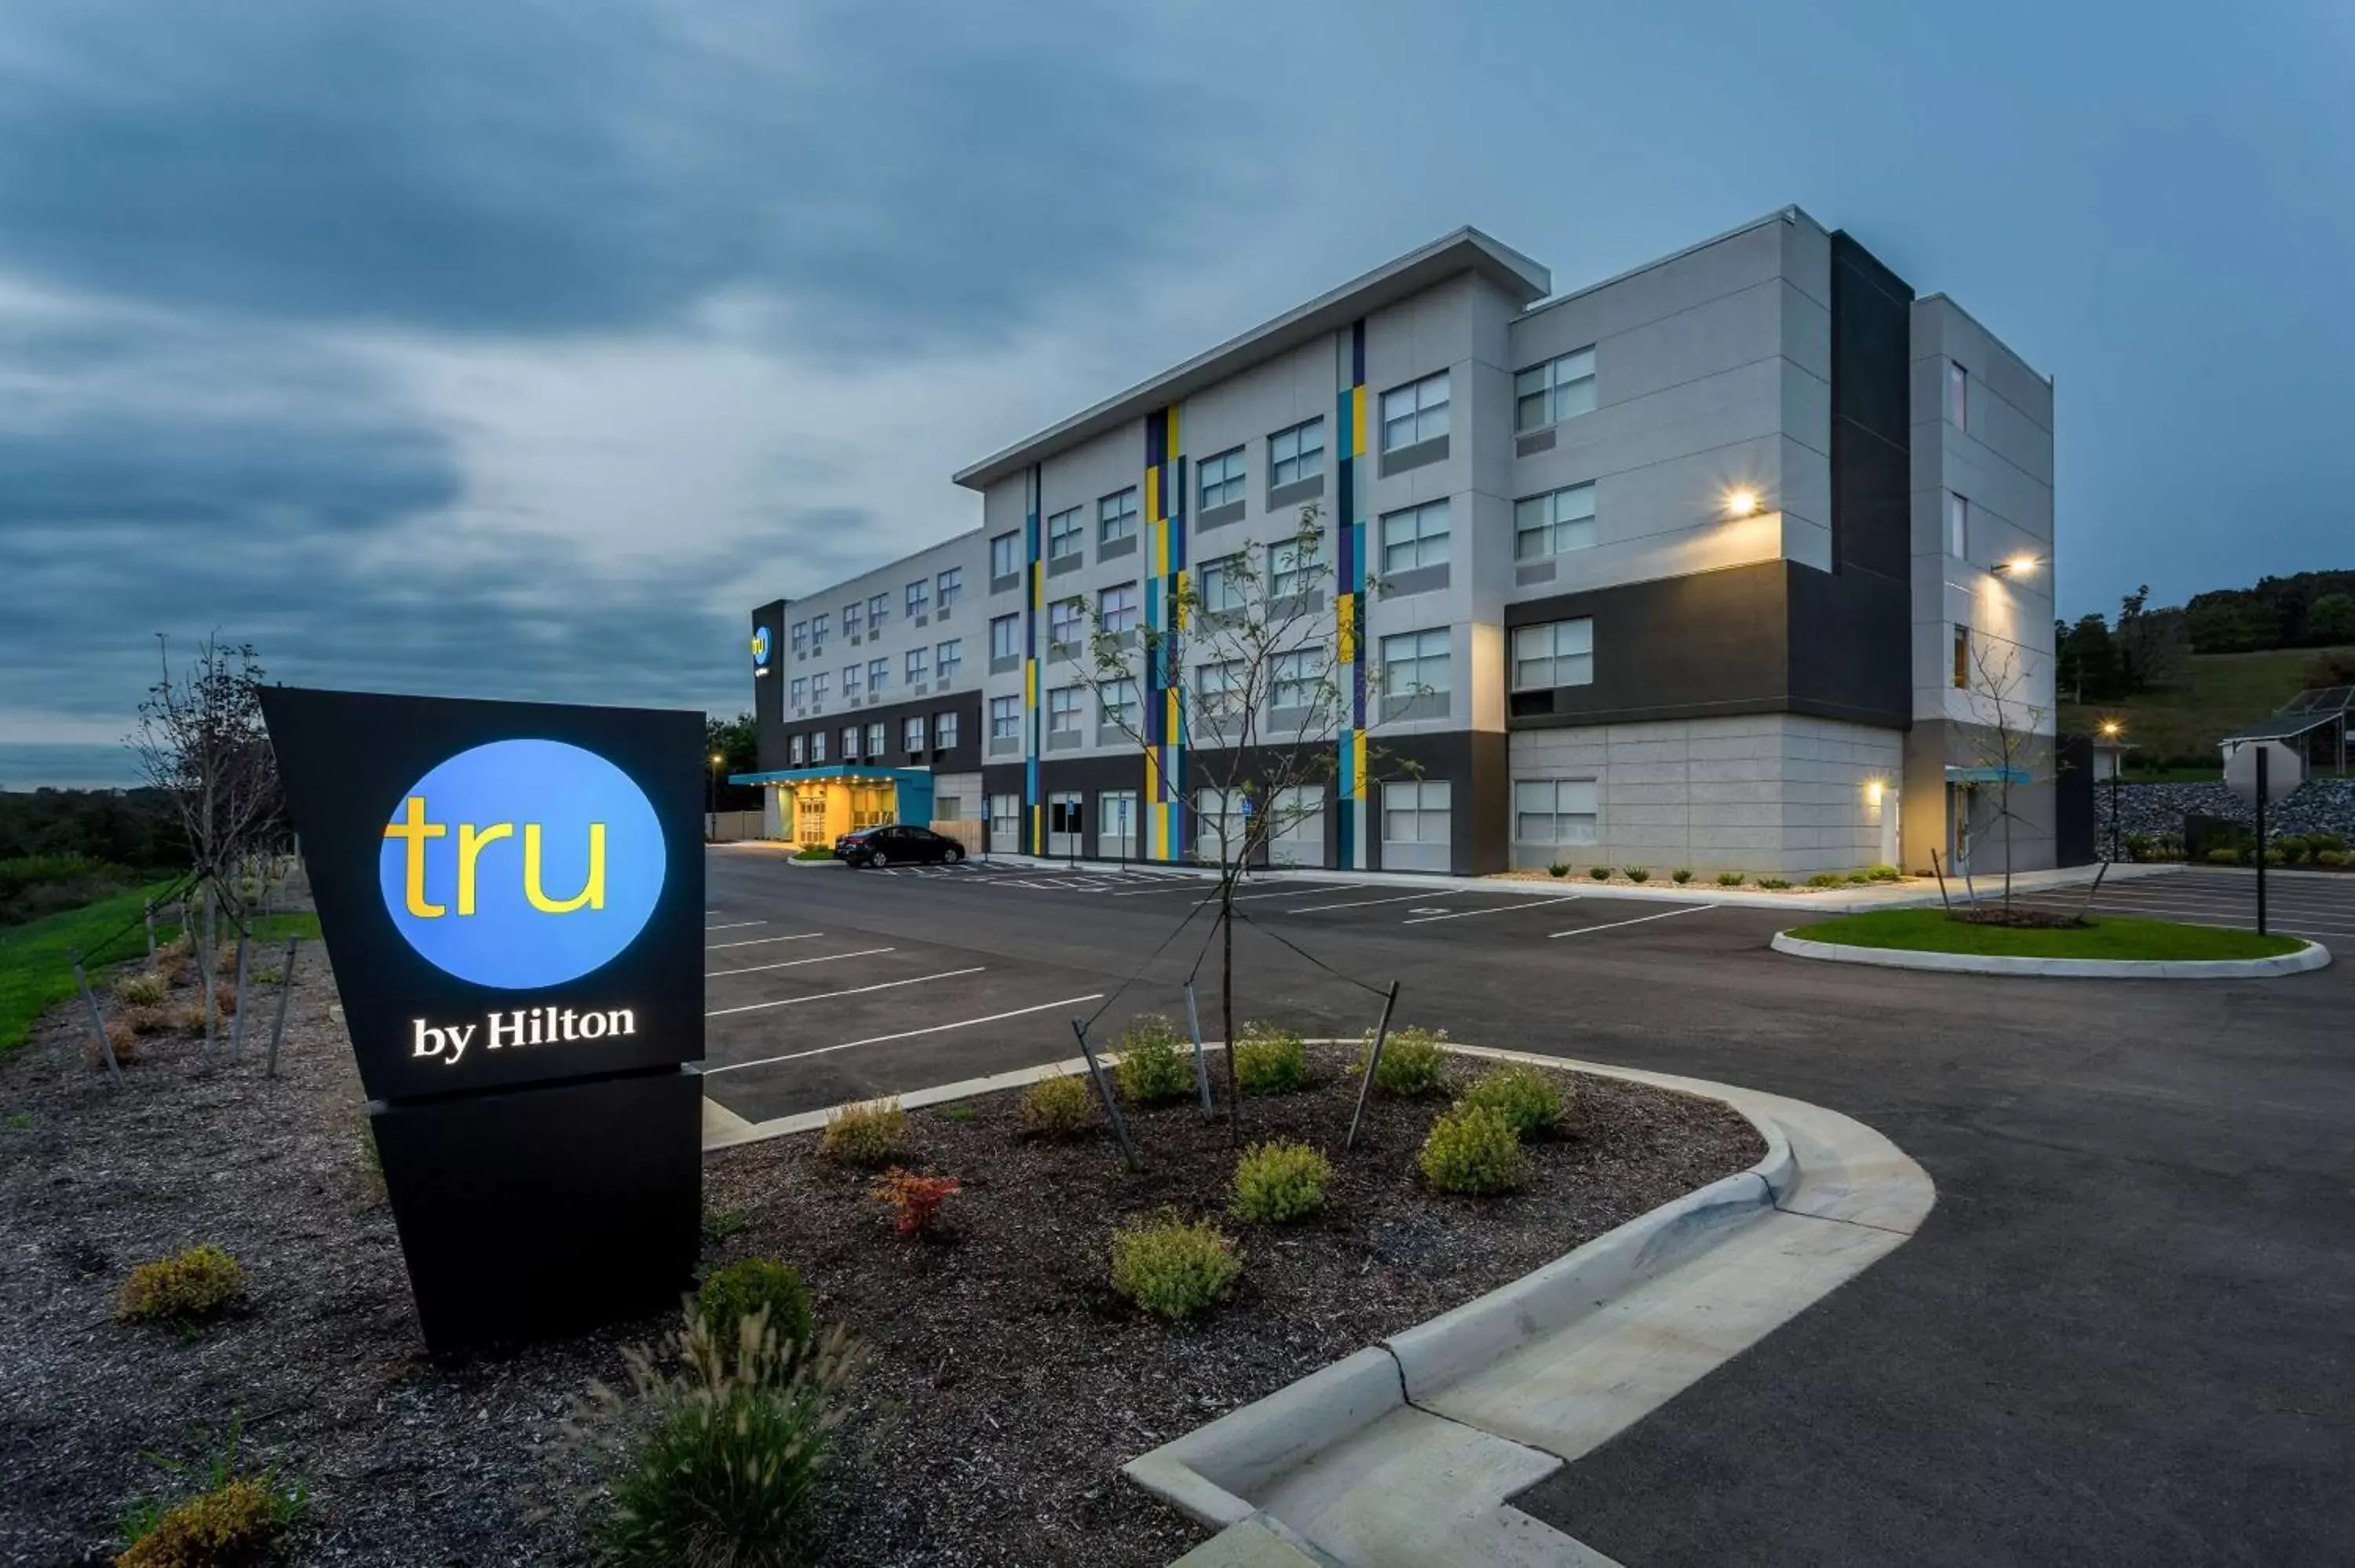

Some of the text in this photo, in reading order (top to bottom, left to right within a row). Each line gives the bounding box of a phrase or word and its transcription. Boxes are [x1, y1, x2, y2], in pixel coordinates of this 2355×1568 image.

[384, 796, 606, 918] tru
[412, 1006, 636, 1065] by Hilton
